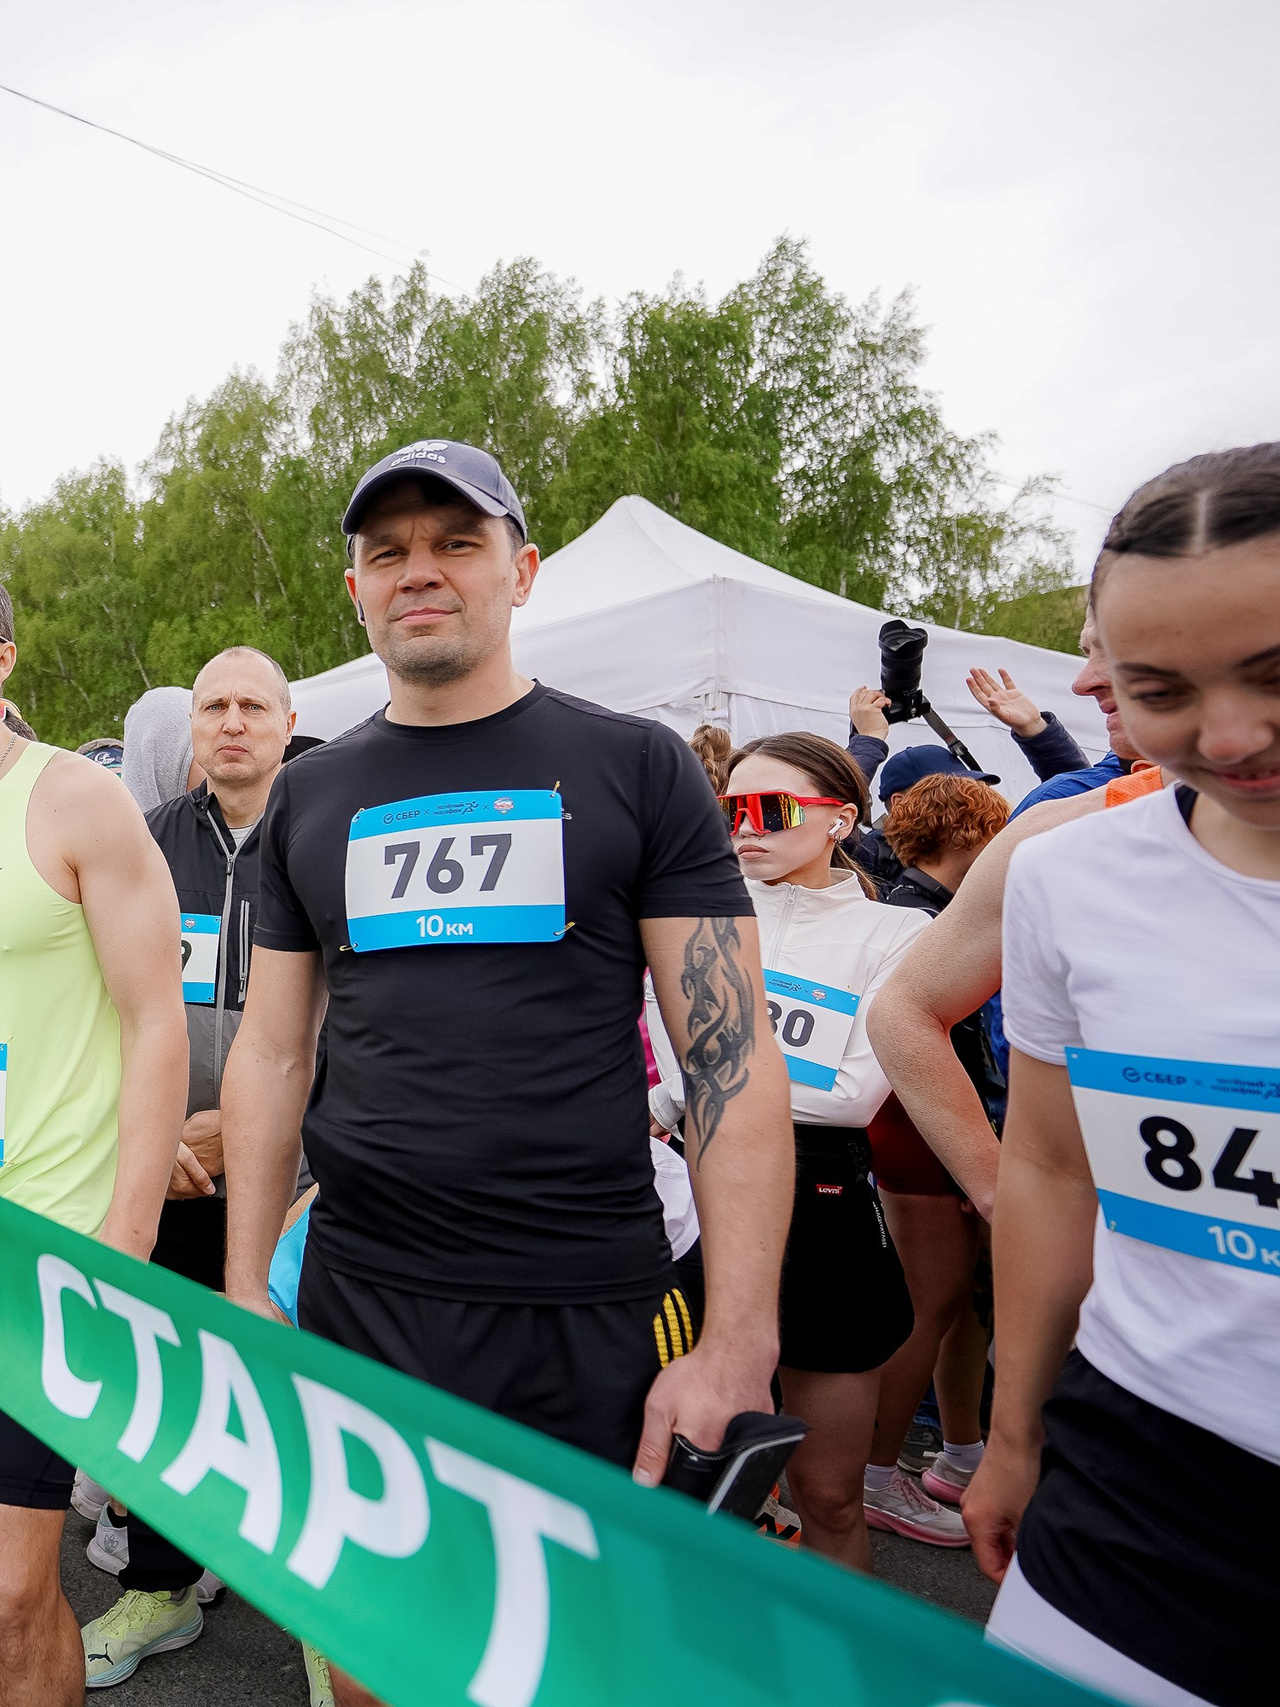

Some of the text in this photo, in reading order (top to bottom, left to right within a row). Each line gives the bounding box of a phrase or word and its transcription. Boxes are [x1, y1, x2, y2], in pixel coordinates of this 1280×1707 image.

[391, 451, 447, 467] adidas
[395, 809, 421, 821] СБЕР
[384, 833, 512, 899] 767
[36, 1253, 601, 1707] СТАРТ
